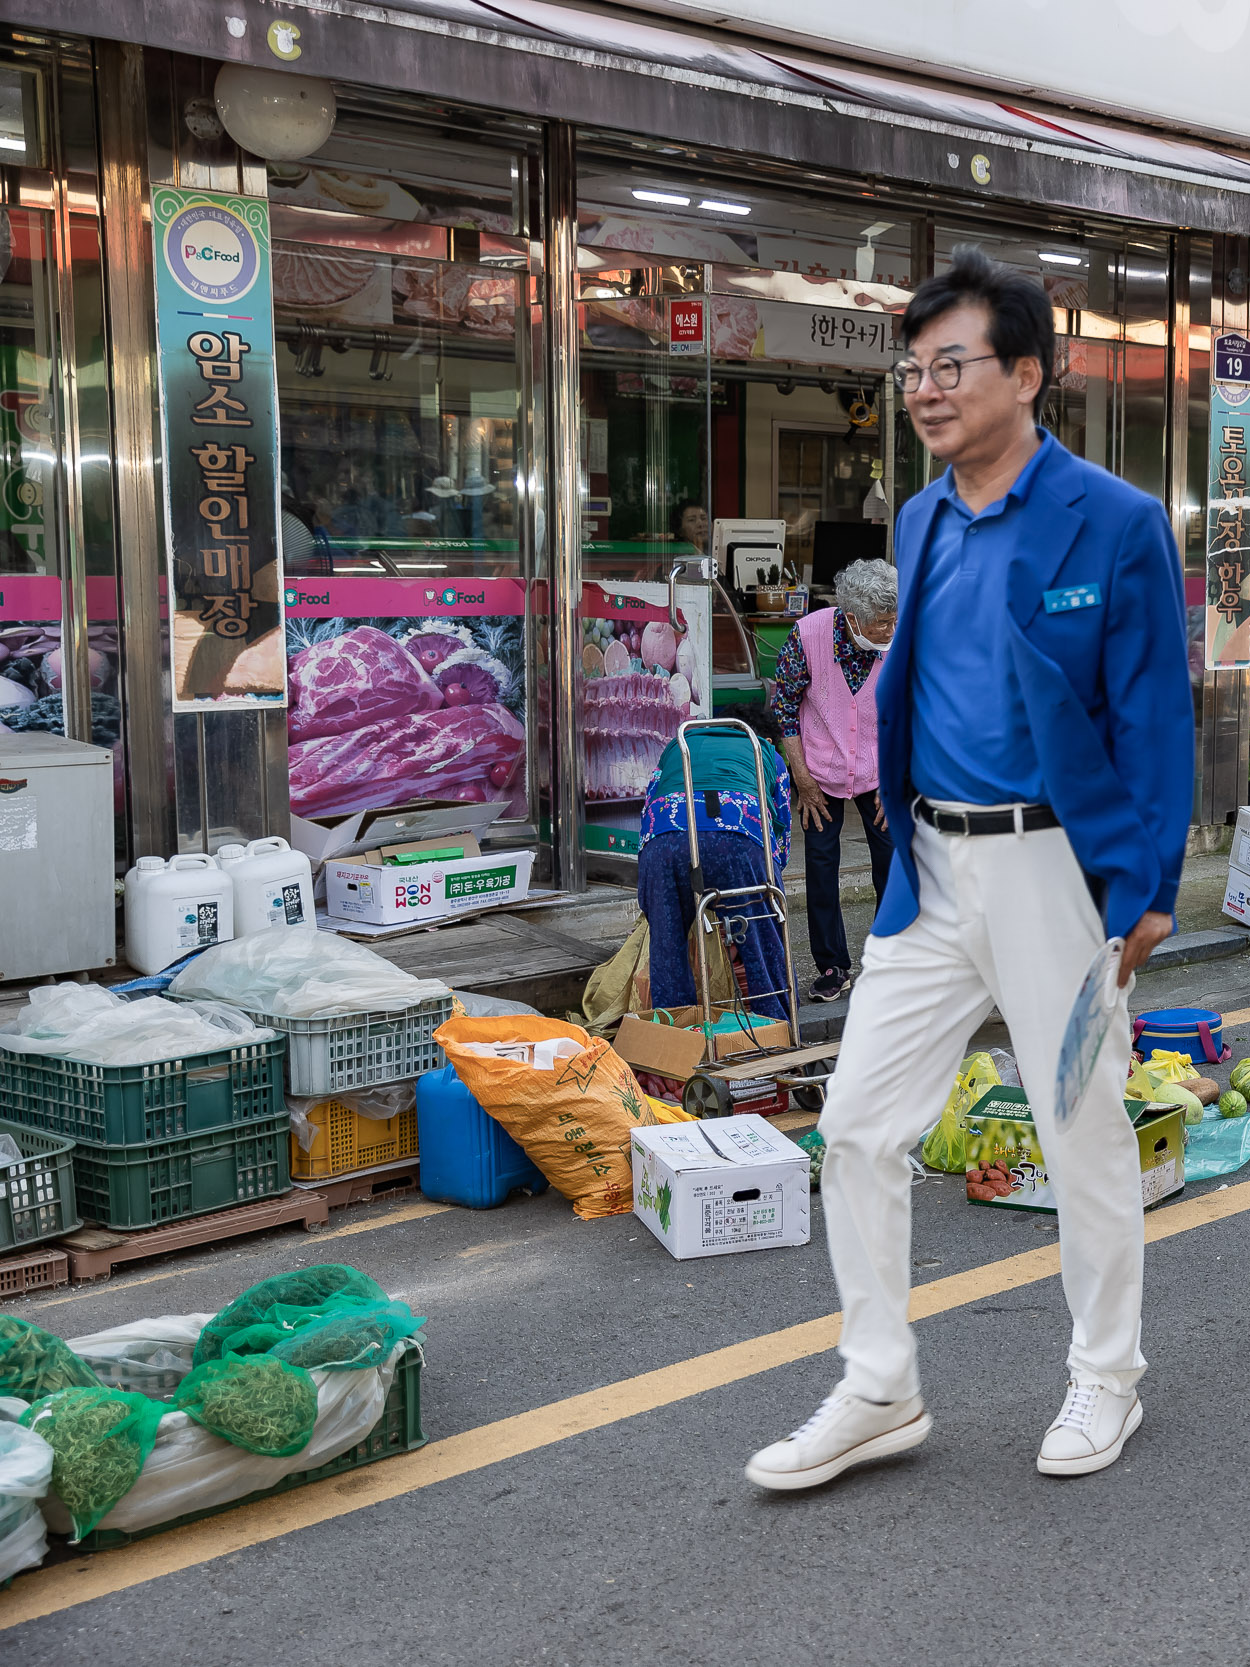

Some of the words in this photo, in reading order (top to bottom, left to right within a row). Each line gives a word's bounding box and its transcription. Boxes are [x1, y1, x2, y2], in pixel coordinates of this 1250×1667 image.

[189, 279, 239, 298] 피앤씨푸드
[675, 313, 698, 328] 에스원
[186, 331, 254, 427] 암소
[1226, 357, 1243, 377] 19
[189, 443, 259, 640] 할인매장
[1216, 562, 1245, 623] 한우
[1010, 1162, 1049, 1193] 고구마
